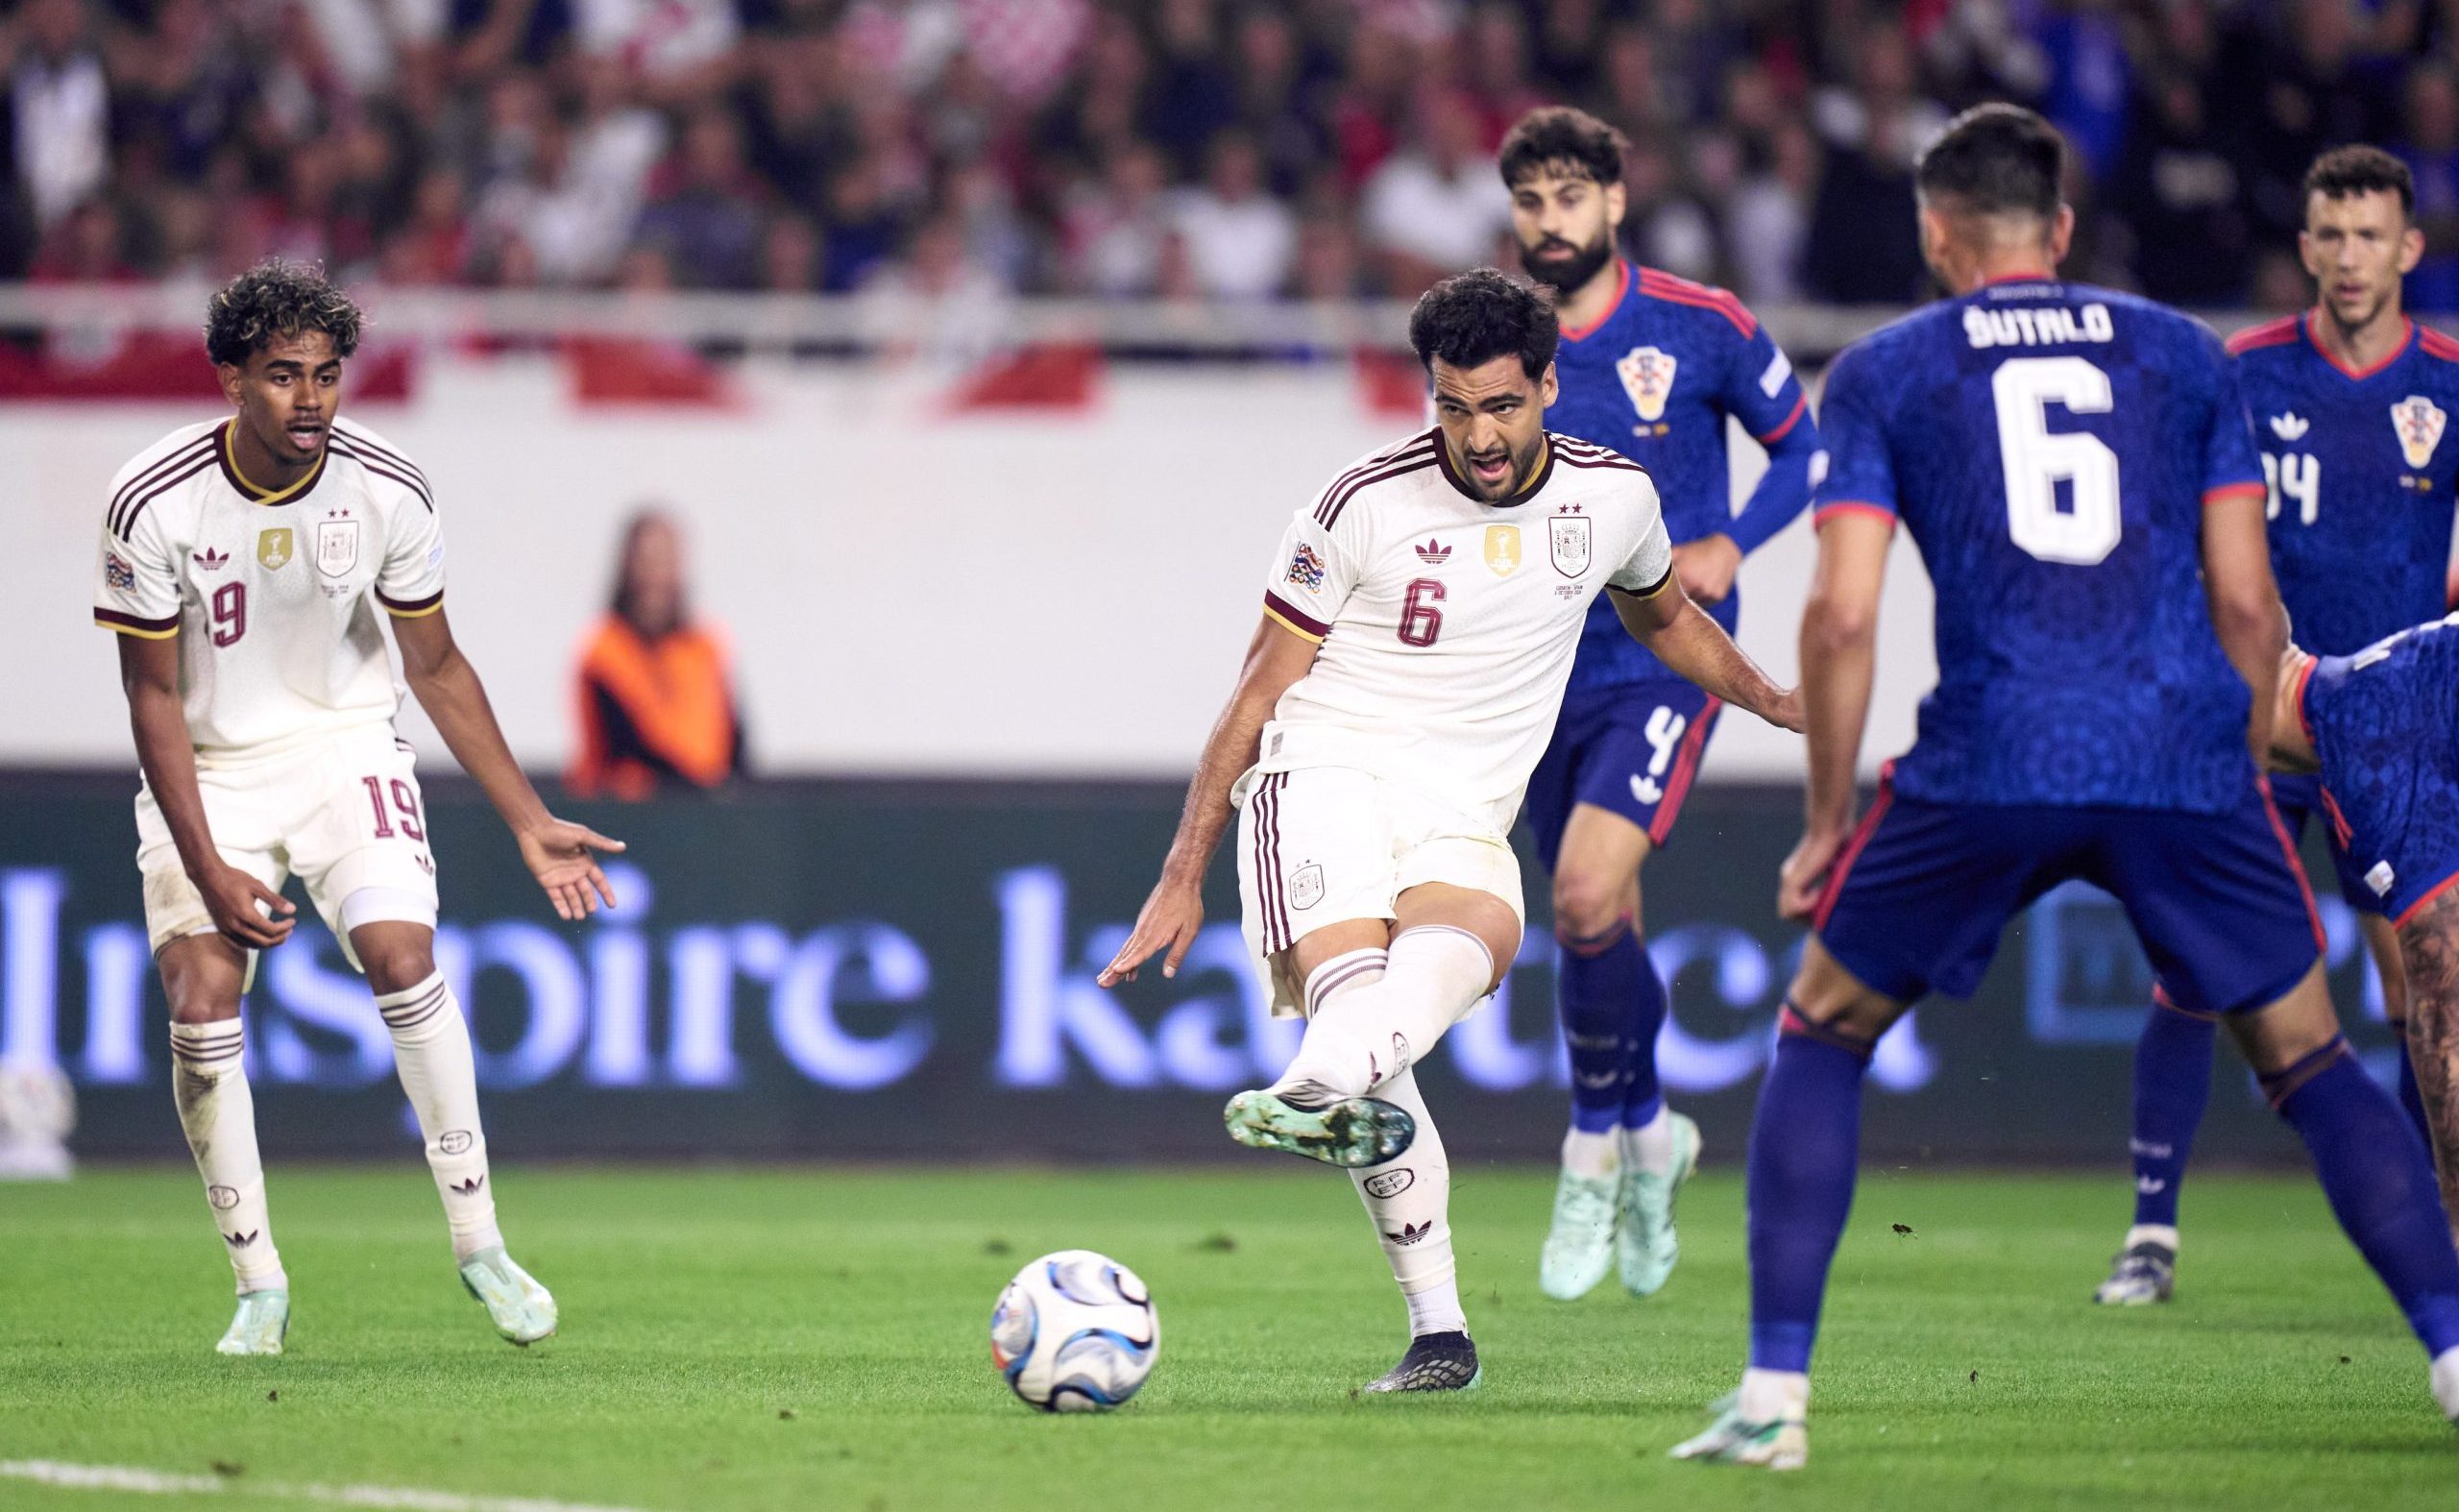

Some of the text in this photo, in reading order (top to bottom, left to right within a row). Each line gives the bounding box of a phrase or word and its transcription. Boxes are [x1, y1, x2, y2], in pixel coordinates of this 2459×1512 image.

[1991, 356, 2122, 565] 6
[1397, 577, 1448, 648] 6
[1643, 705, 1686, 776] 4
[361, 775, 424, 843] 19
